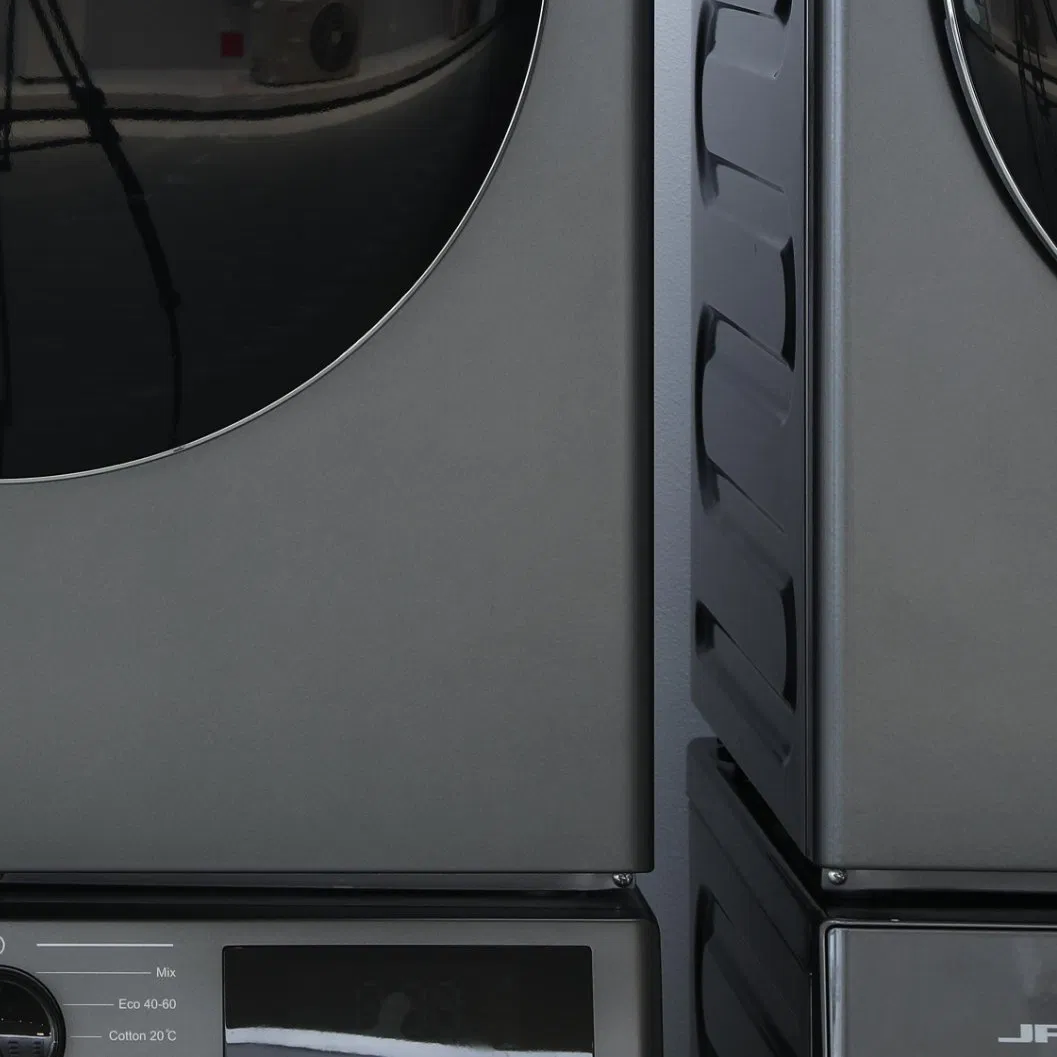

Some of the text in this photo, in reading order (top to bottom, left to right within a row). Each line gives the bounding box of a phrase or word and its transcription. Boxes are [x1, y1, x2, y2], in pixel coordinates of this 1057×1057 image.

[156, 967, 176, 978] Mix
[118, 999, 176, 1010] Eco 40-60
[109, 1030, 146, 1041] Cotton
